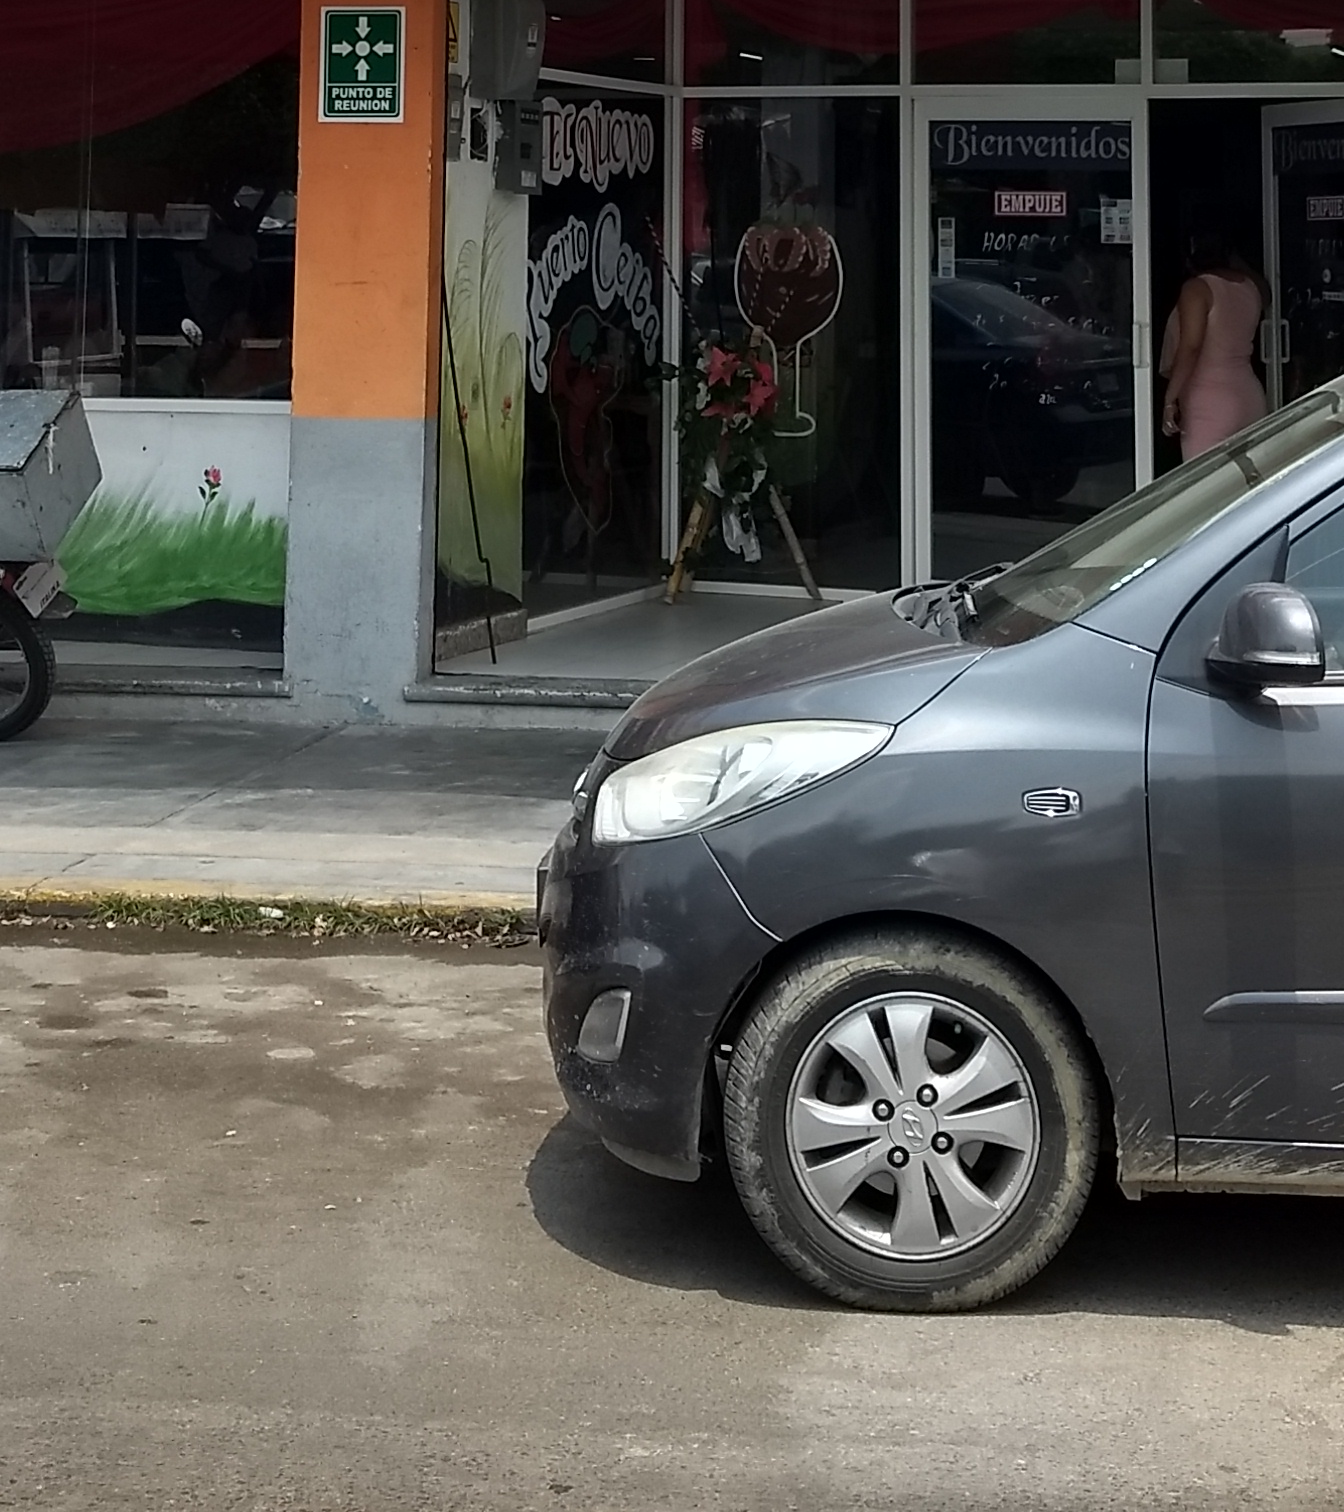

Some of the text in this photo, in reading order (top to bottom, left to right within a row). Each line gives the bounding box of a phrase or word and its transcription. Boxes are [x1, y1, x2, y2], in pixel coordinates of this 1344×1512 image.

[331, 87, 393, 99] PUNTO DE
[334, 99, 390, 111] REUNION
[934, 124, 1130, 165] Bienvenidos
[1000, 194, 1061, 212] EMPUJE
